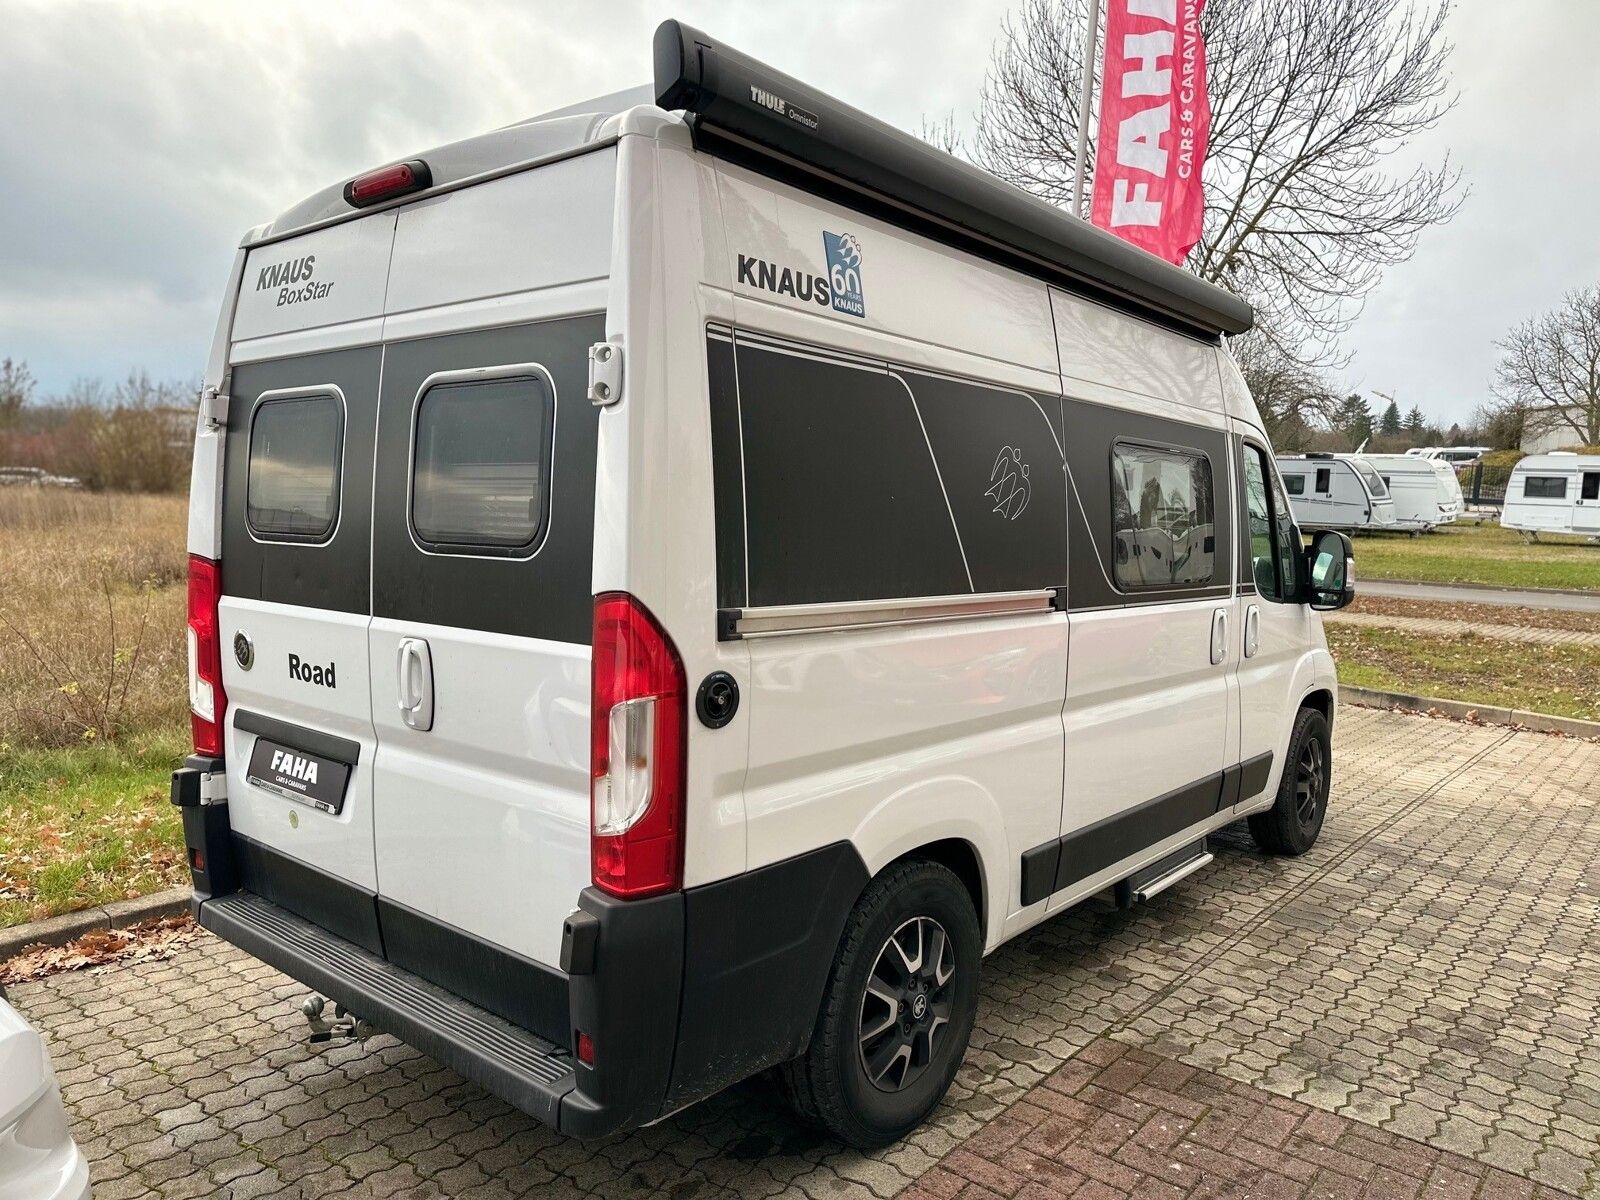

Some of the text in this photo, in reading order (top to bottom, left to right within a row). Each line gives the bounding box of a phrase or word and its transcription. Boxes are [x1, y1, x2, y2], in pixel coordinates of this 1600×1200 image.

[750, 84, 818, 130] THULE Omnistor
[1180, 109, 1194, 122] &
[1178, 127, 1194, 179] CARS
[255, 255, 316, 292] KNAUS
[737, 253, 831, 307] KNAUS
[831, 263, 861, 296] 60
[276, 281, 335, 307] BoxStar
[834, 297, 864, 314] KNAUS
[288, 653, 337, 689] Road
[270, 749, 319, 785] FAHA
